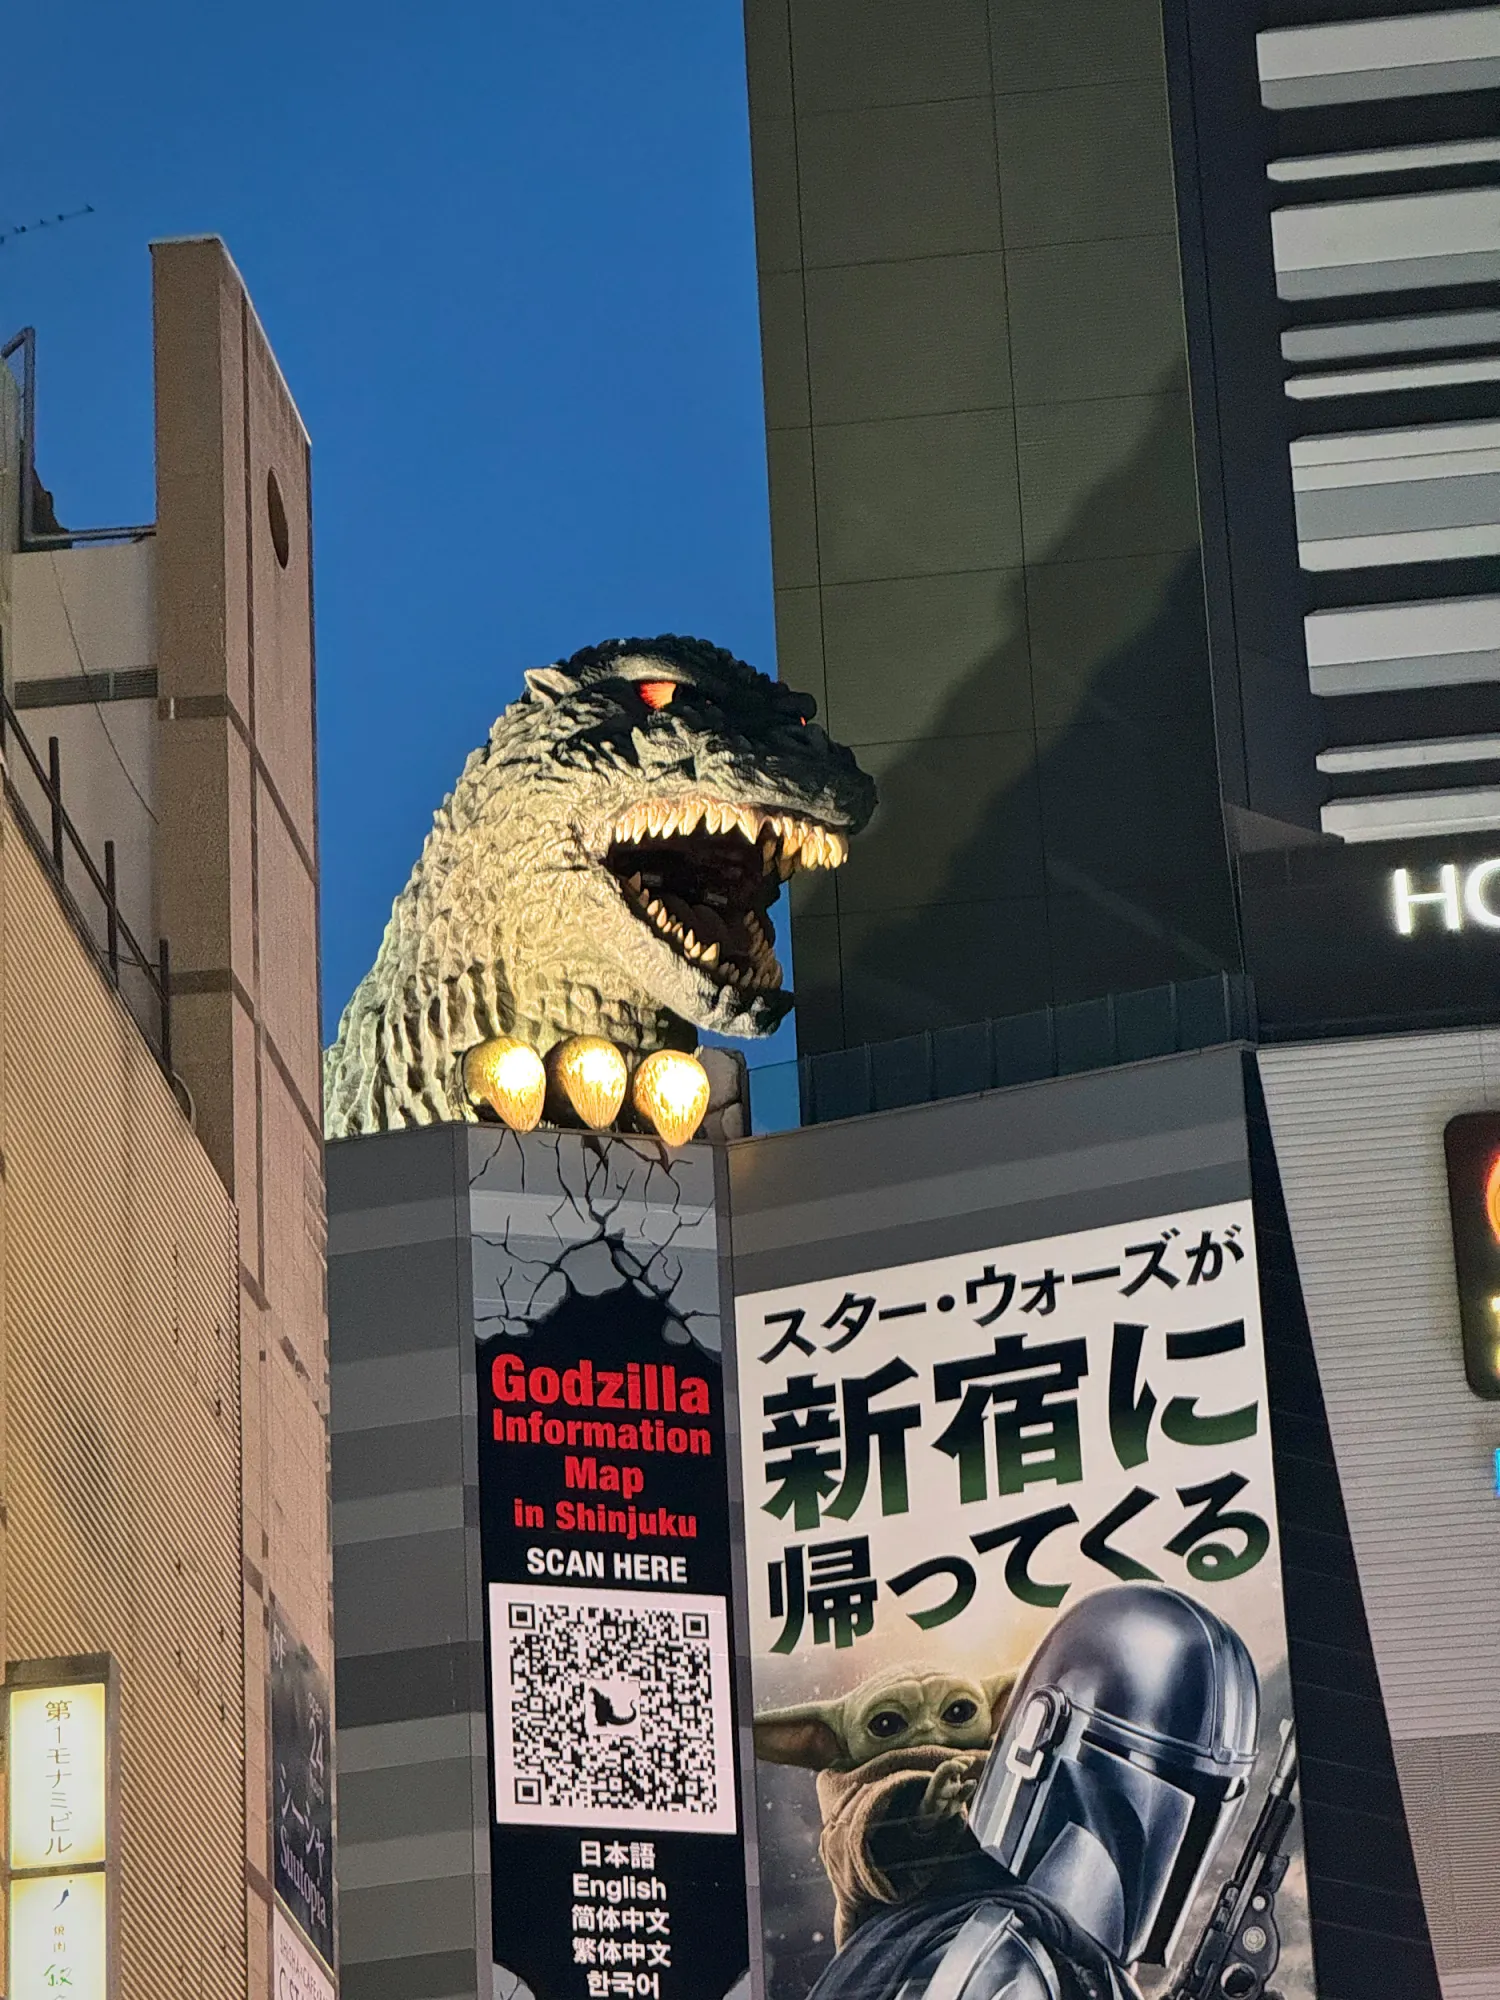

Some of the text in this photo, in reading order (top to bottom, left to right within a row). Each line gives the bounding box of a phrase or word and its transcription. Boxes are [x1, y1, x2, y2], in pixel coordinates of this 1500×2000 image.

[757, 1224, 1244, 1364] スター・ウォーズが
[491, 1353, 711, 1415] Godzilla
[492, 1408, 712, 1456] Information
[761, 1318, 1259, 1531] 新宿に
[564, 1456, 645, 1499] Map
[513, 1499, 697, 1541] in Shinjuku
[526, 1547, 688, 1584] SCAN HERE
[767, 1471, 1271, 1654] 帰ってくる
[580, 1840, 656, 1870] 日本語
[572, 1872, 667, 1903] English
[571, 1936, 672, 1968] 繁体中文
[586, 1969, 661, 2000] 한국어
